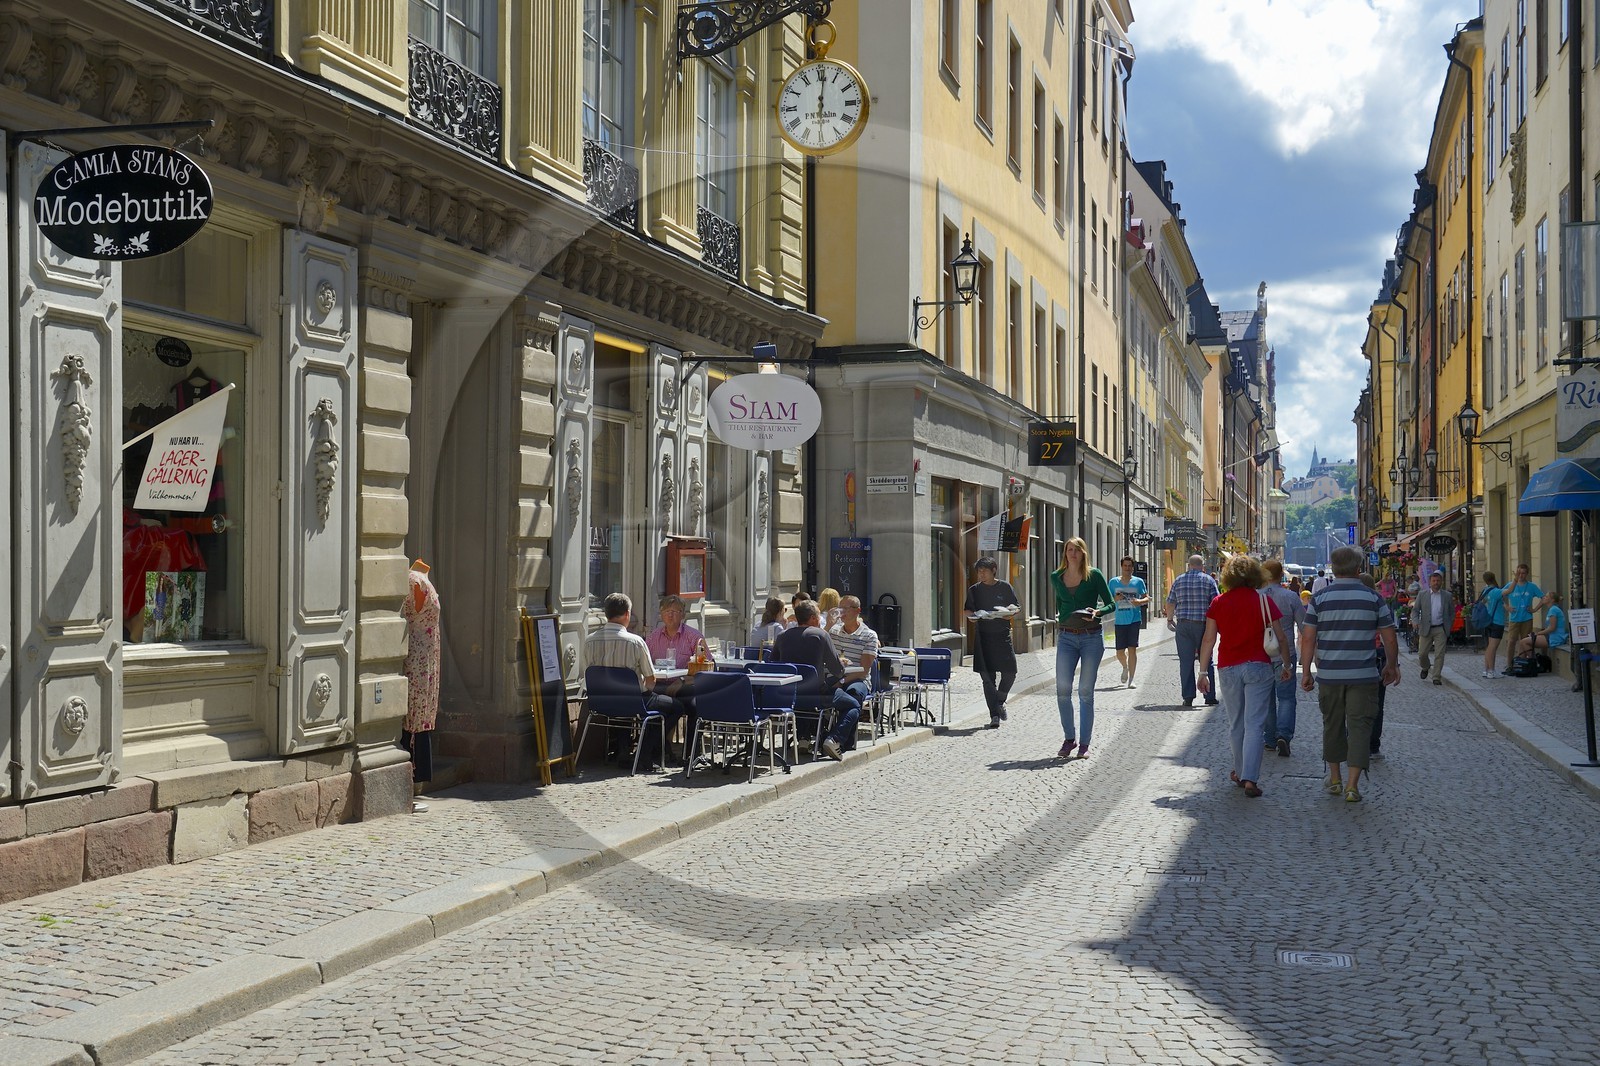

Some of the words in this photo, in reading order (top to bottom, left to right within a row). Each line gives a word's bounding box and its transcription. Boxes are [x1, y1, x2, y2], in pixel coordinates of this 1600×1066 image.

[54, 151, 121, 190] GAMLA
[127, 149, 193, 186] STANS
[36, 189, 208, 226] Modebutik
[729, 394, 798, 420] SIAM
[169, 437, 178, 446] NU
[178, 437, 191, 446] HAR
[1048, 429, 1074, 438] Nygatan
[159, 450, 205, 467] LAGER-
[1041, 442, 1063, 459] 27
[146, 468, 208, 487] GALLRING
[149, 489, 196, 501] Välkommen!
[1014, 486, 1023, 494] 27
